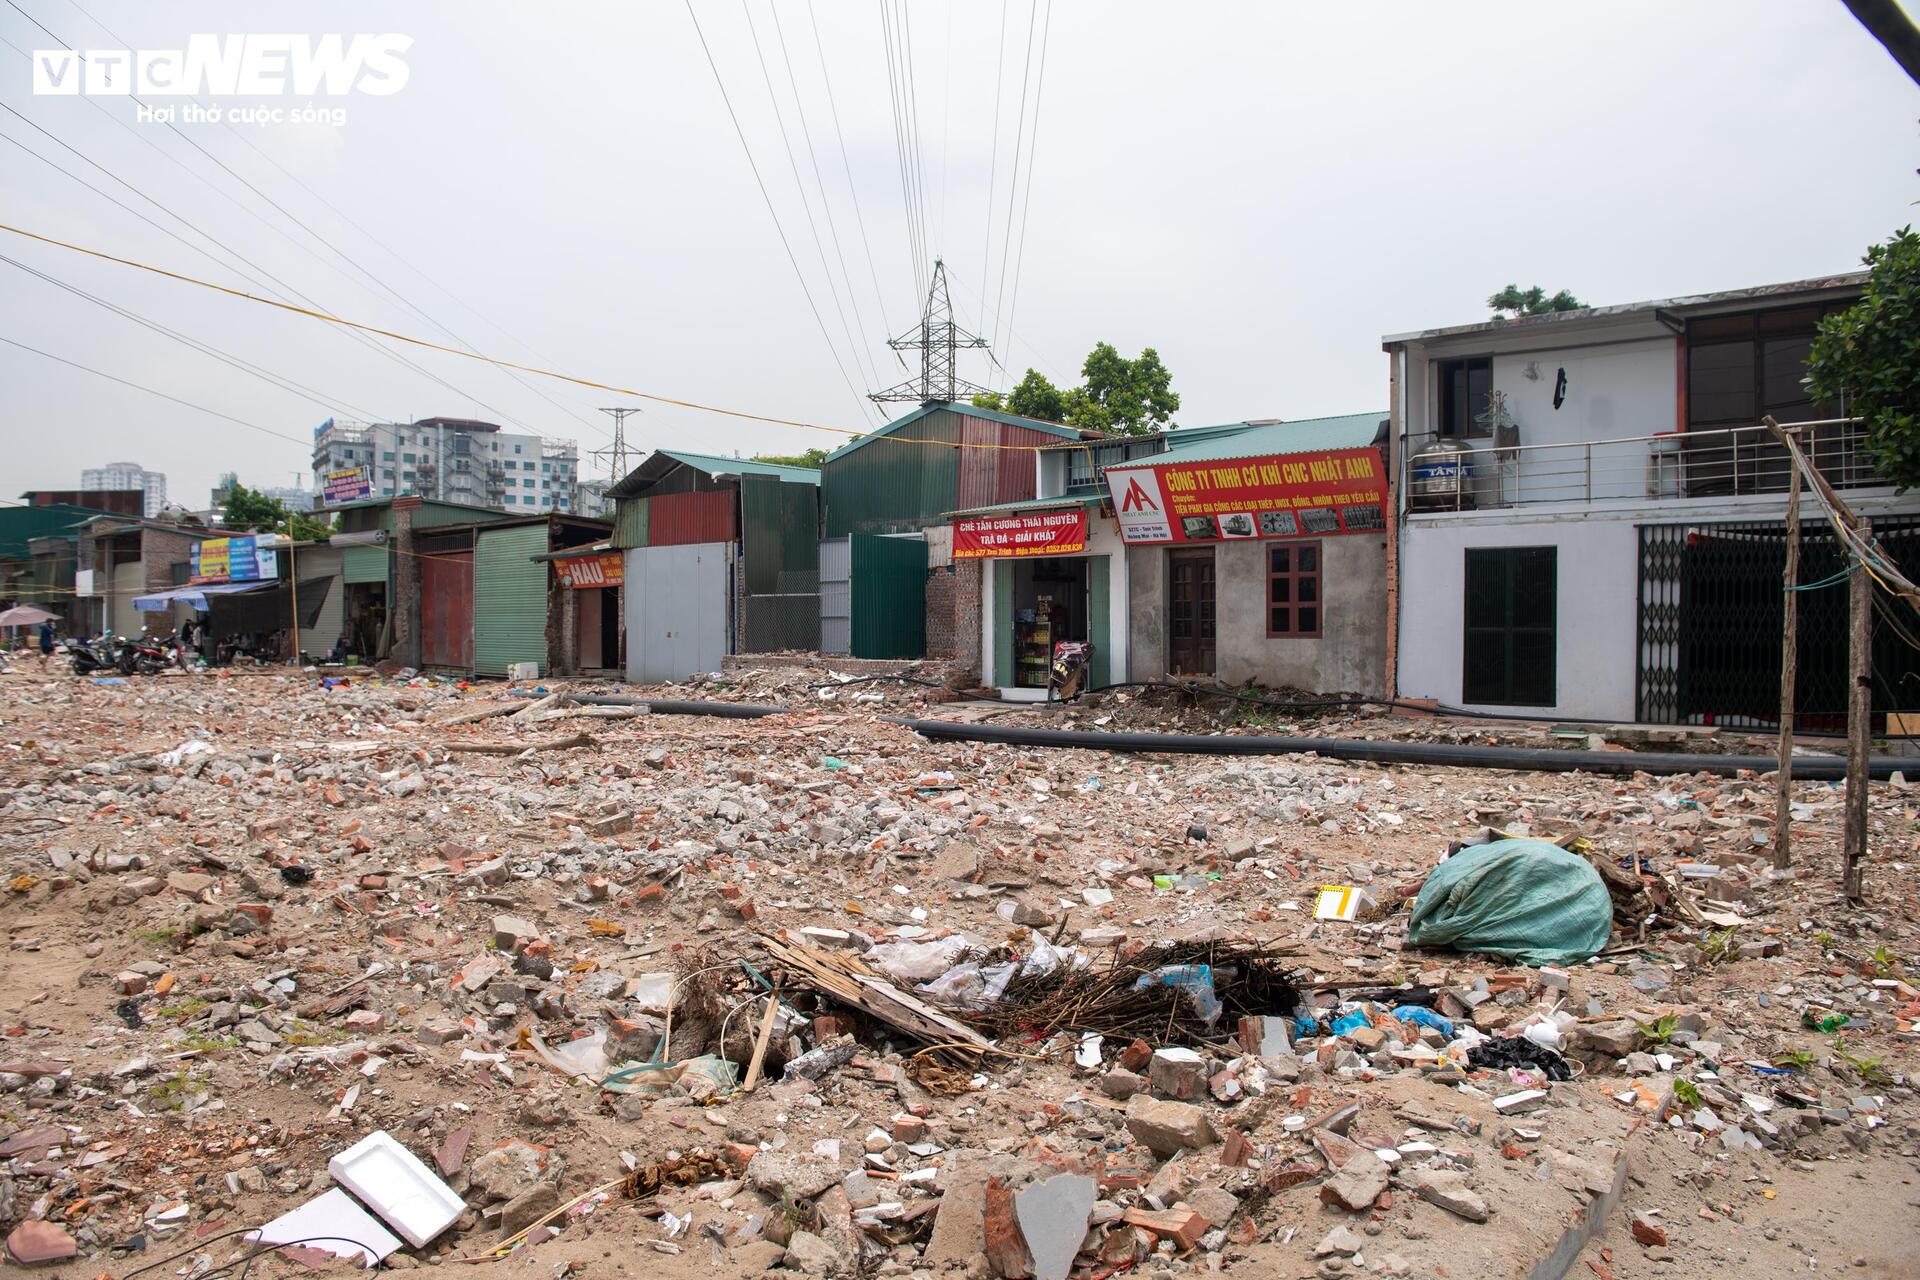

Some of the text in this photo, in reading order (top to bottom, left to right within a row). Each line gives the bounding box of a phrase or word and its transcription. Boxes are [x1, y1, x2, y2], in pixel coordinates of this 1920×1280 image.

[1165, 455, 1374, 491] CÔNG TY TNHH CƠ KHÍ CNC NHẬT ANH
[977, 519, 992, 530] TÂN
[993, 518, 1021, 530] CƯƠNG
[1022, 516, 1041, 528] THÁI
[1043, 513, 1078, 526] NGUYÊN
[980, 533, 995, 545] TRÀ
[997, 532, 1008, 544] ĐÁ
[1015, 531, 1032, 543] GIẢI
[1033, 529, 1056, 542] KHÁT
[569, 558, 604, 585] HÀU
